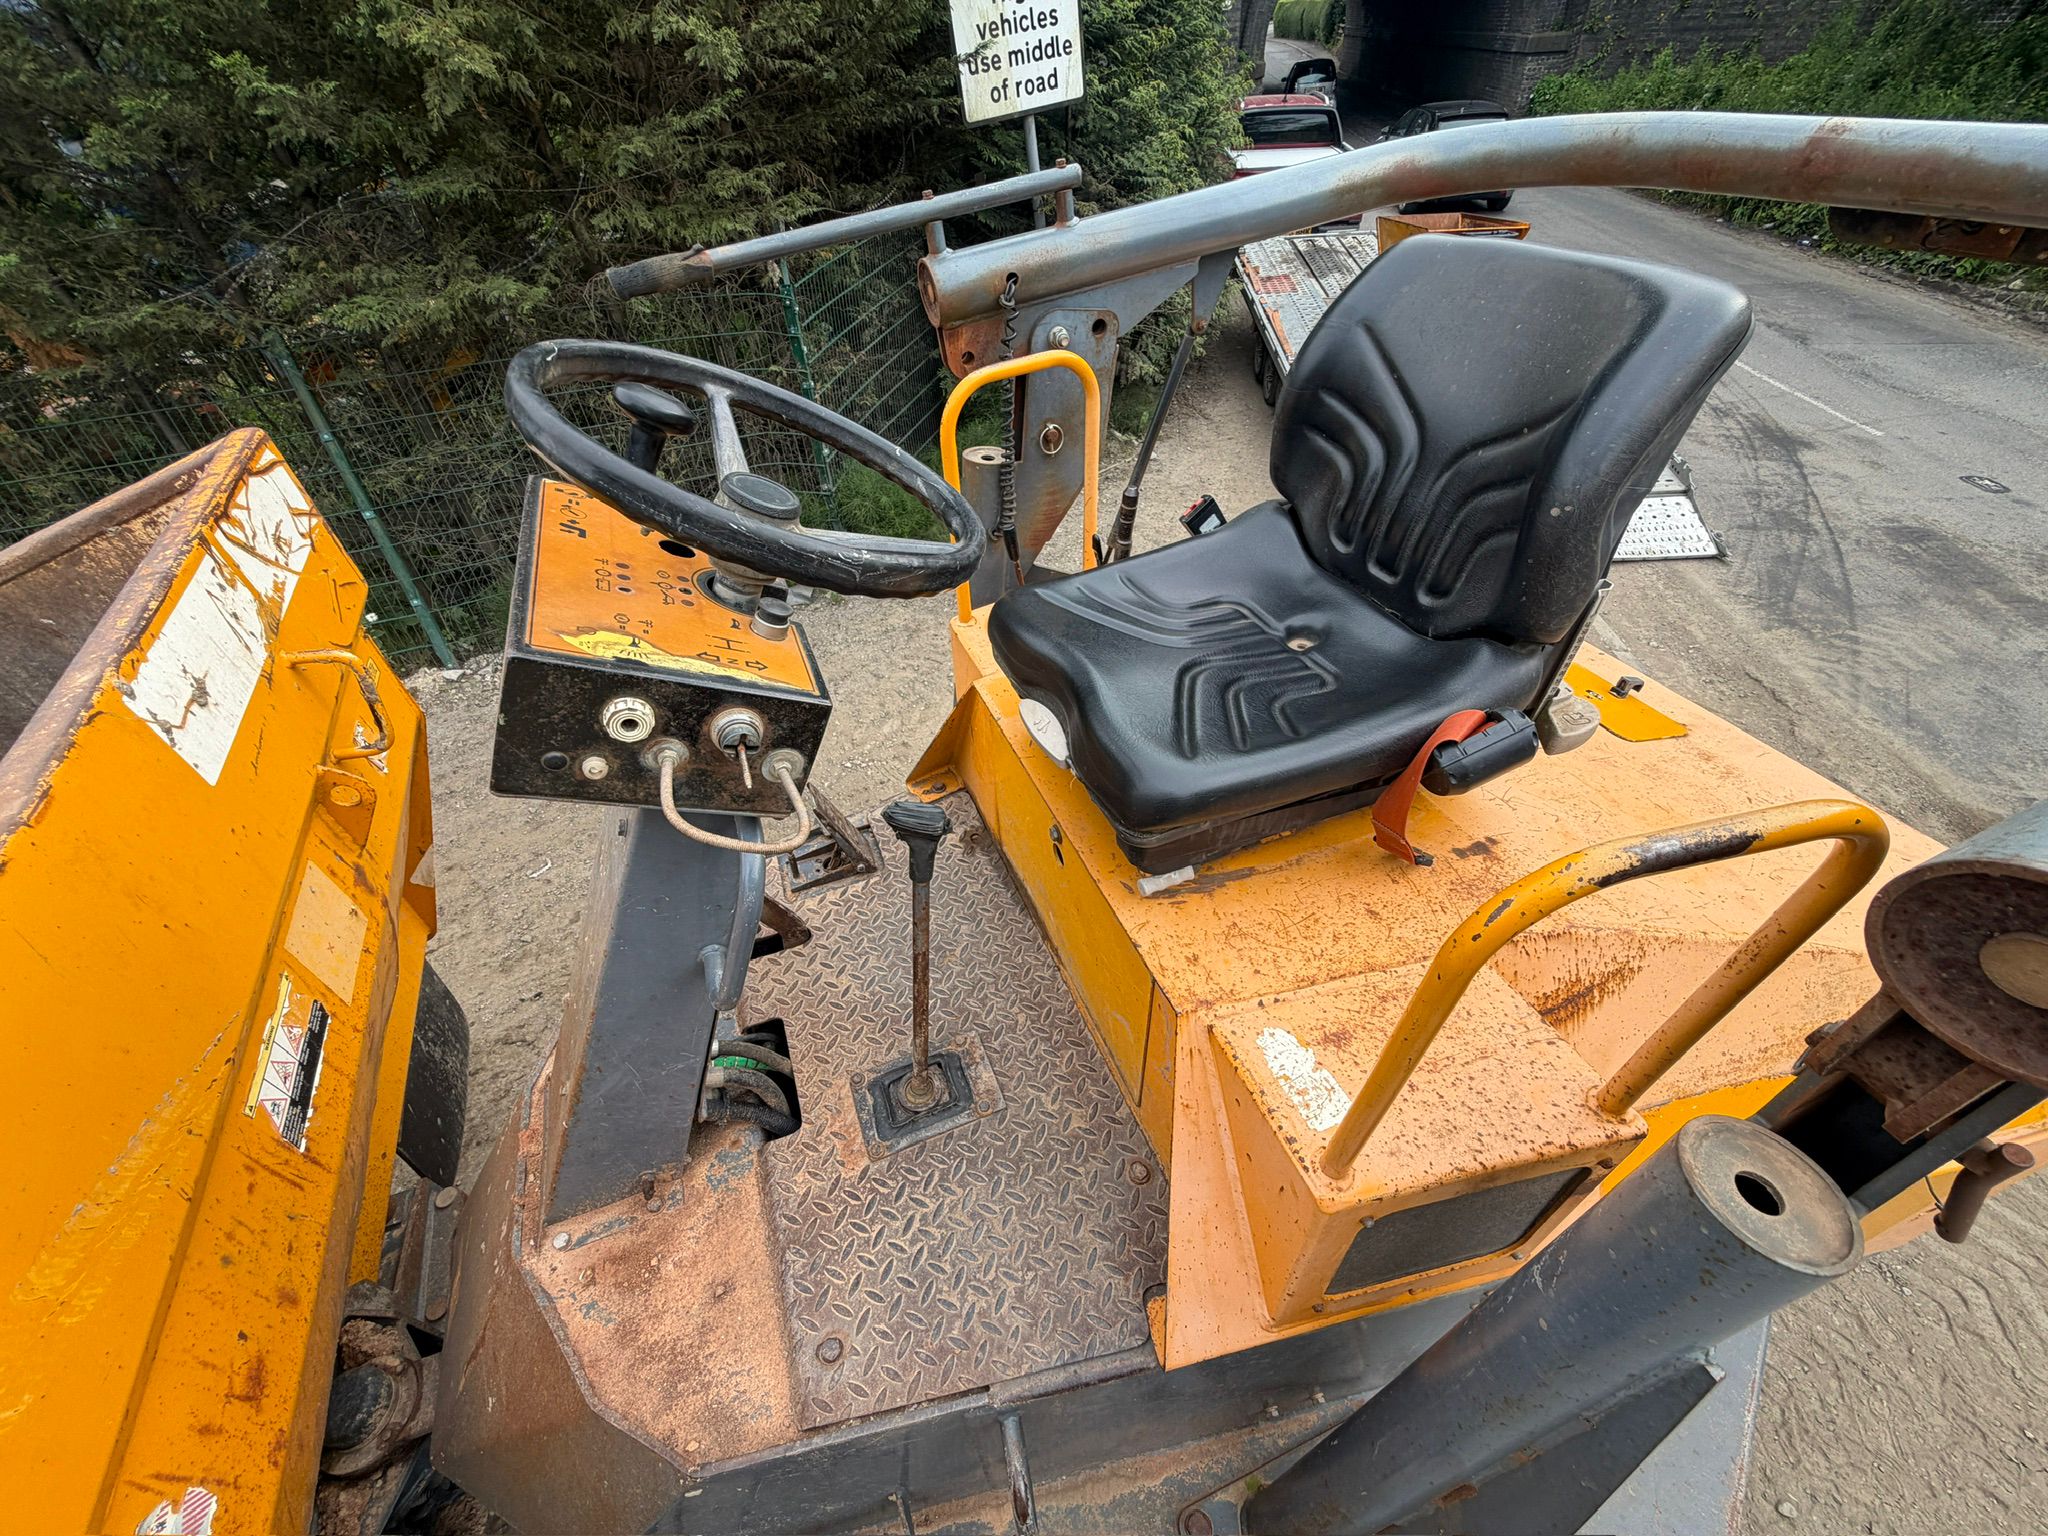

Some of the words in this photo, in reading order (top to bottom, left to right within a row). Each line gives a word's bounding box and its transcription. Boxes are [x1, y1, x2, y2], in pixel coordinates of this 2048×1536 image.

[976, 7, 1059, 41] vehicles
[967, 53, 1002, 76] use
[1008, 35, 1073, 68] middle
[990, 78, 1009, 103] of
[1015, 67, 1059, 98] road
